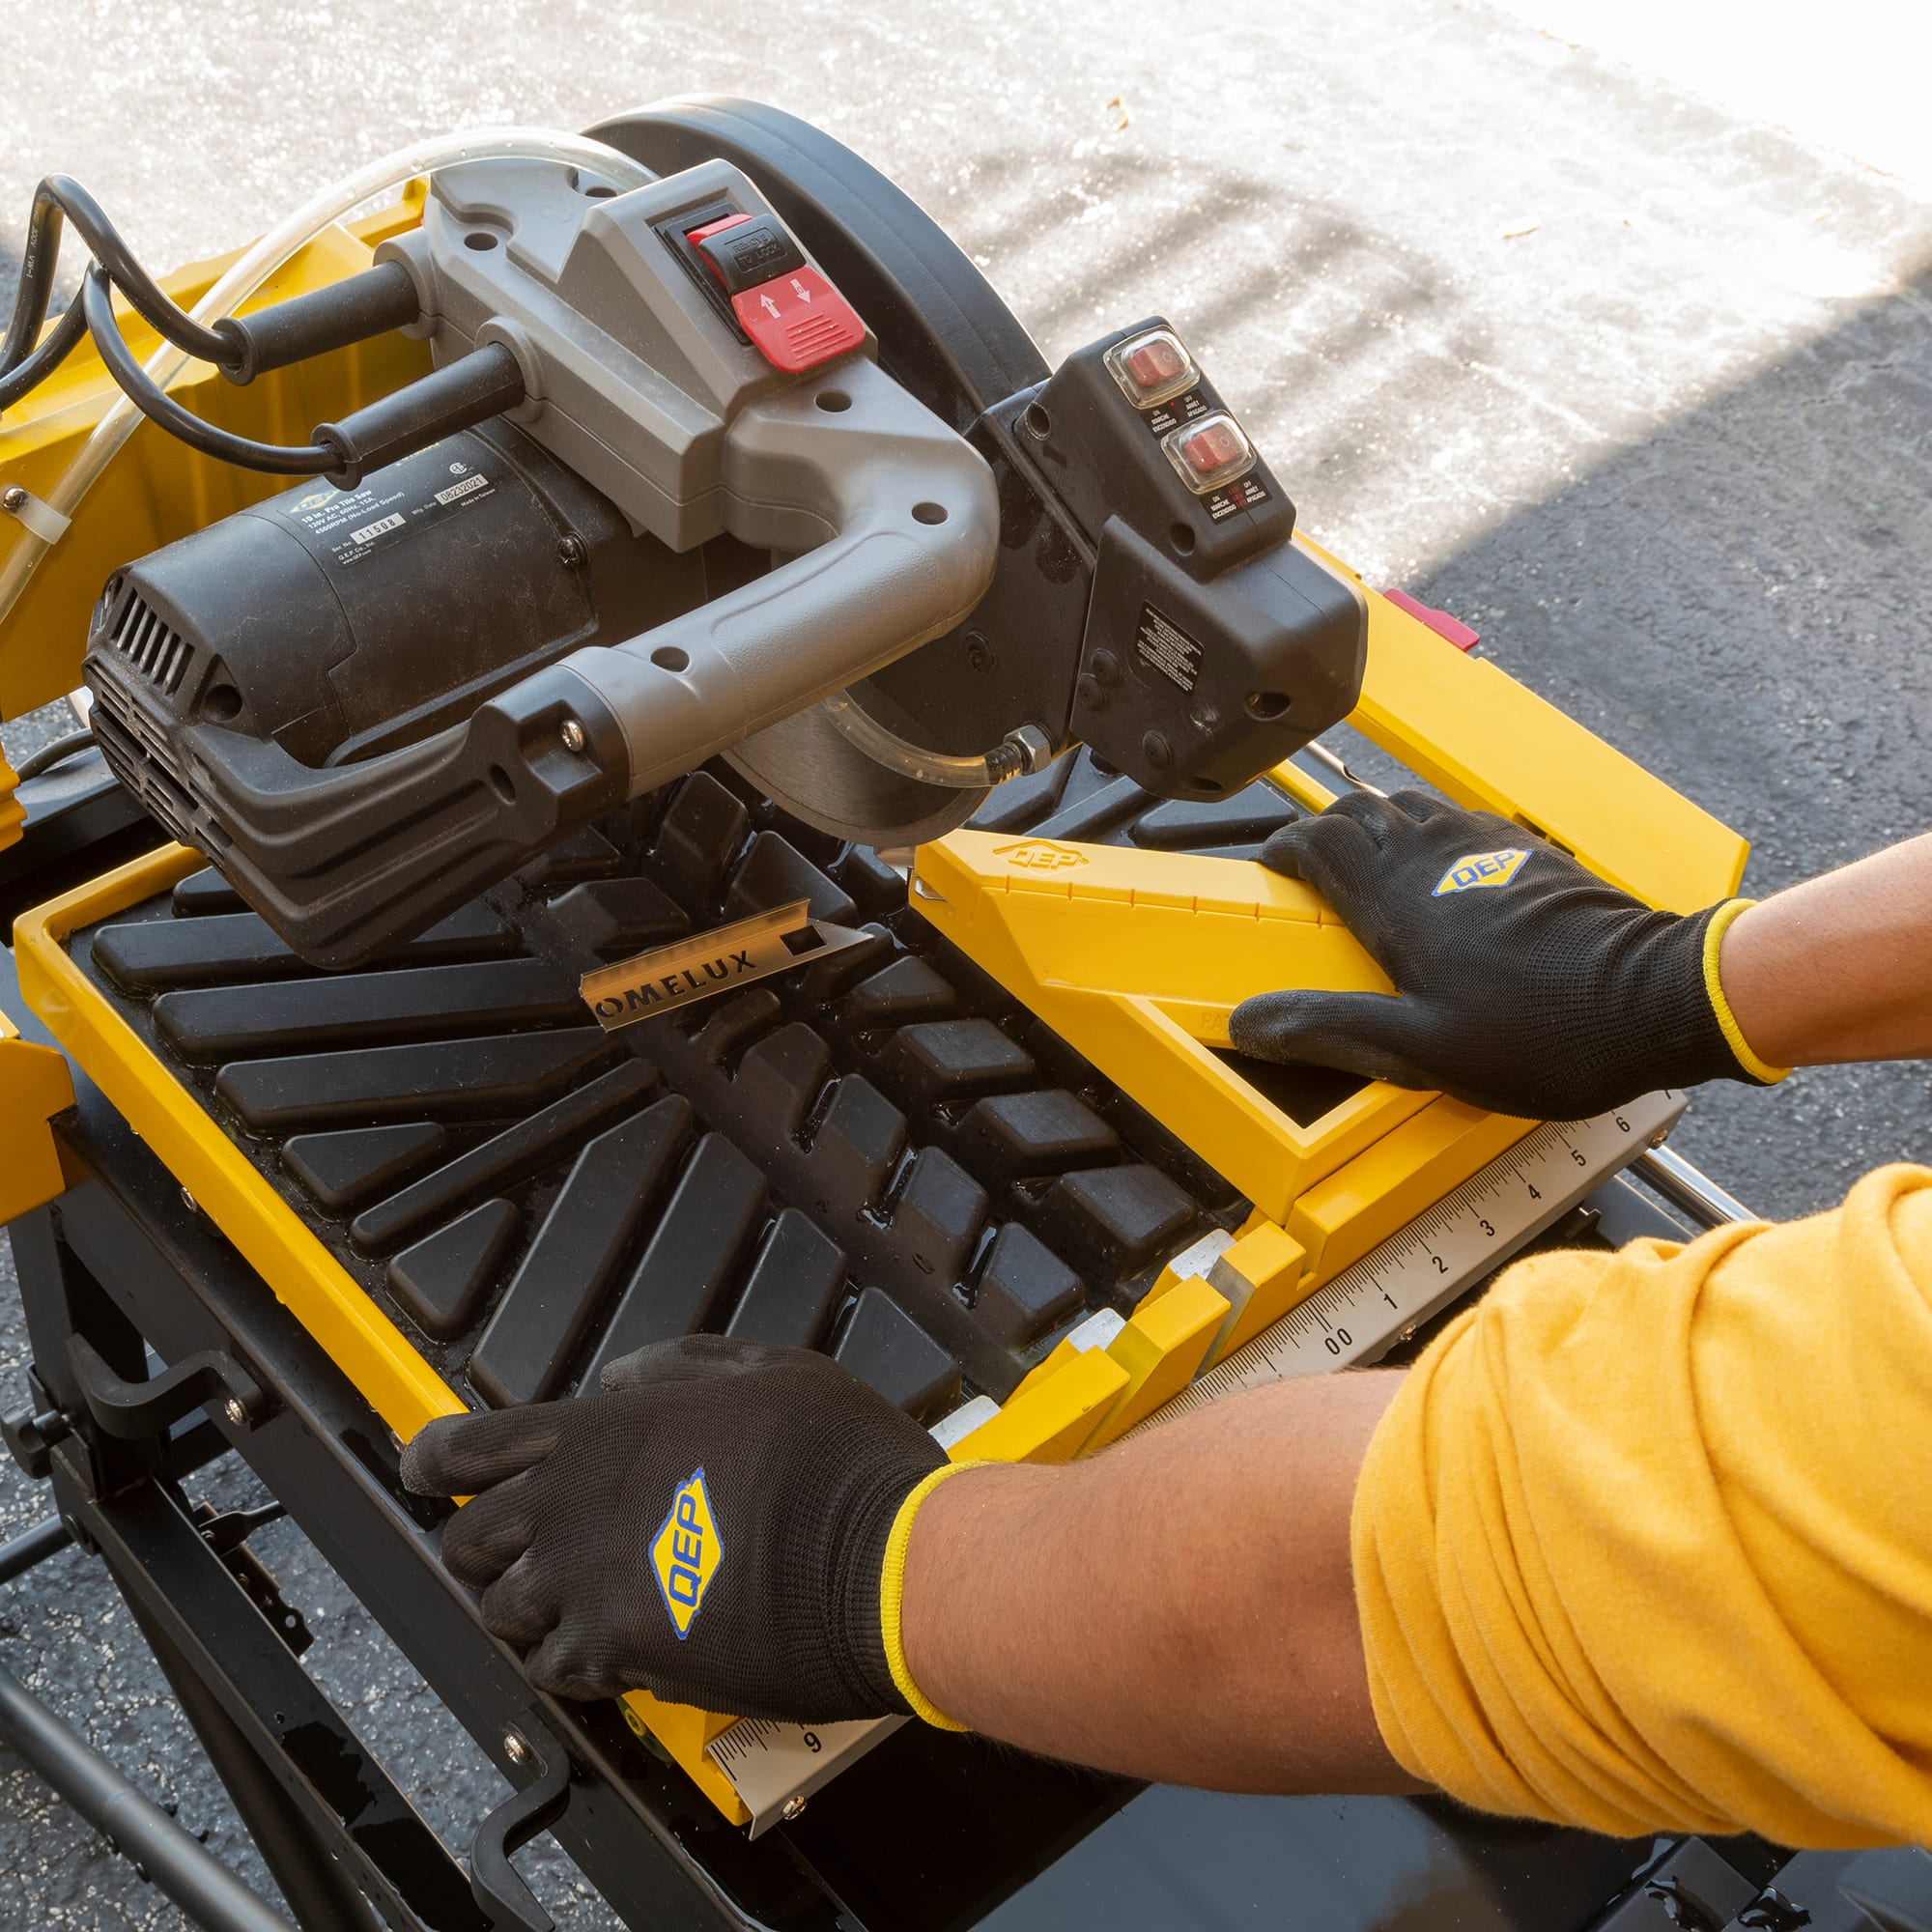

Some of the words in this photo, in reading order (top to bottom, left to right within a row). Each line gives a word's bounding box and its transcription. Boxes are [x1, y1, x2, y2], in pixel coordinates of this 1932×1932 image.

[440, 477, 484, 501] 08232021
[301, 515, 313, 524] 10
[325, 504, 340, 513] Pro
[339, 497, 355, 507] Tile
[354, 490, 372, 500] Saw
[1008, 849, 1079, 868] QEP
[1451, 852, 1515, 888] QEP
[595, 951, 757, 1018] OMELUX
[1615, 1117, 1631, 1133] 6
[1571, 1150, 1586, 1167] 5
[1528, 1184, 1542, 1201] 4
[1479, 1219, 1495, 1237] 3
[1432, 1256, 1448, 1275] 2
[1382, 1293, 1398, 1310] 1
[668, 1493, 703, 1607] QEP
[804, 1731, 821, 1753] 9
